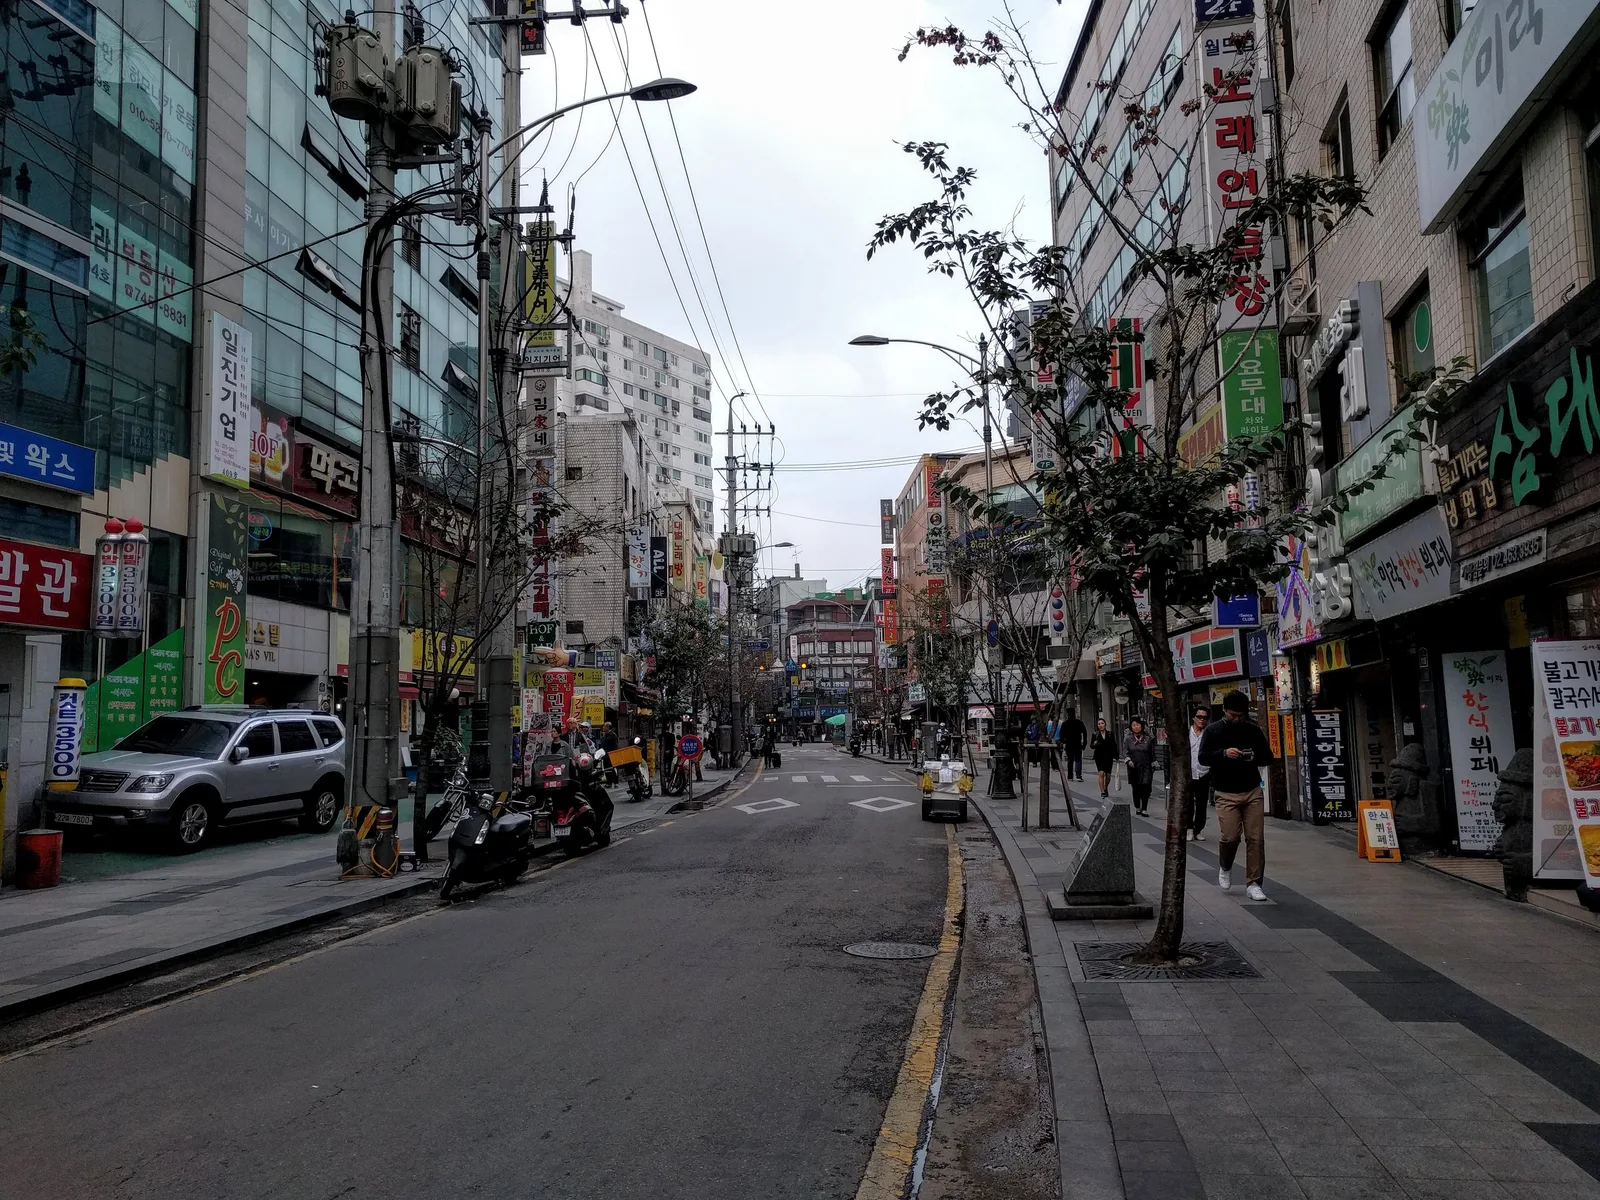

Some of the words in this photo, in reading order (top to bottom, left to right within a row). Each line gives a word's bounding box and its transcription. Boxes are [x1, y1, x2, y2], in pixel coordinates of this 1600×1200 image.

[122, 239, 176, 301] 부동산
[220, 327, 238, 442] 일진기업
[1236, 339, 1267, 415] 가요무대
[533, 397, 548, 446] 김家네
[24, 443, 76, 481] 왁스
[1438, 440, 1490, 493] 불고기주는
[102, 543, 119, 566] 이발
[209, 560, 226, 578] Cafe
[1419, 535, 1451, 577] 뷔페
[208, 597, 242, 697] PC
[529, 623, 555, 635] HOF
[1462, 689, 1490, 734] 한식
[1555, 716, 1595, 738] 불고기
[52, 726, 76, 777] 3500
[1313, 712, 1347, 801] 멀티하우스텔
[1468, 735, 1499, 774] 뷔페
[72, 815, 89, 824] 7800
[1317, 810, 1353, 819] 742-1233
[1324, 801, 1343, 811] 4F
[1367, 811, 1389, 820] 한식
[1375, 822, 1388, 846] 뷔페
